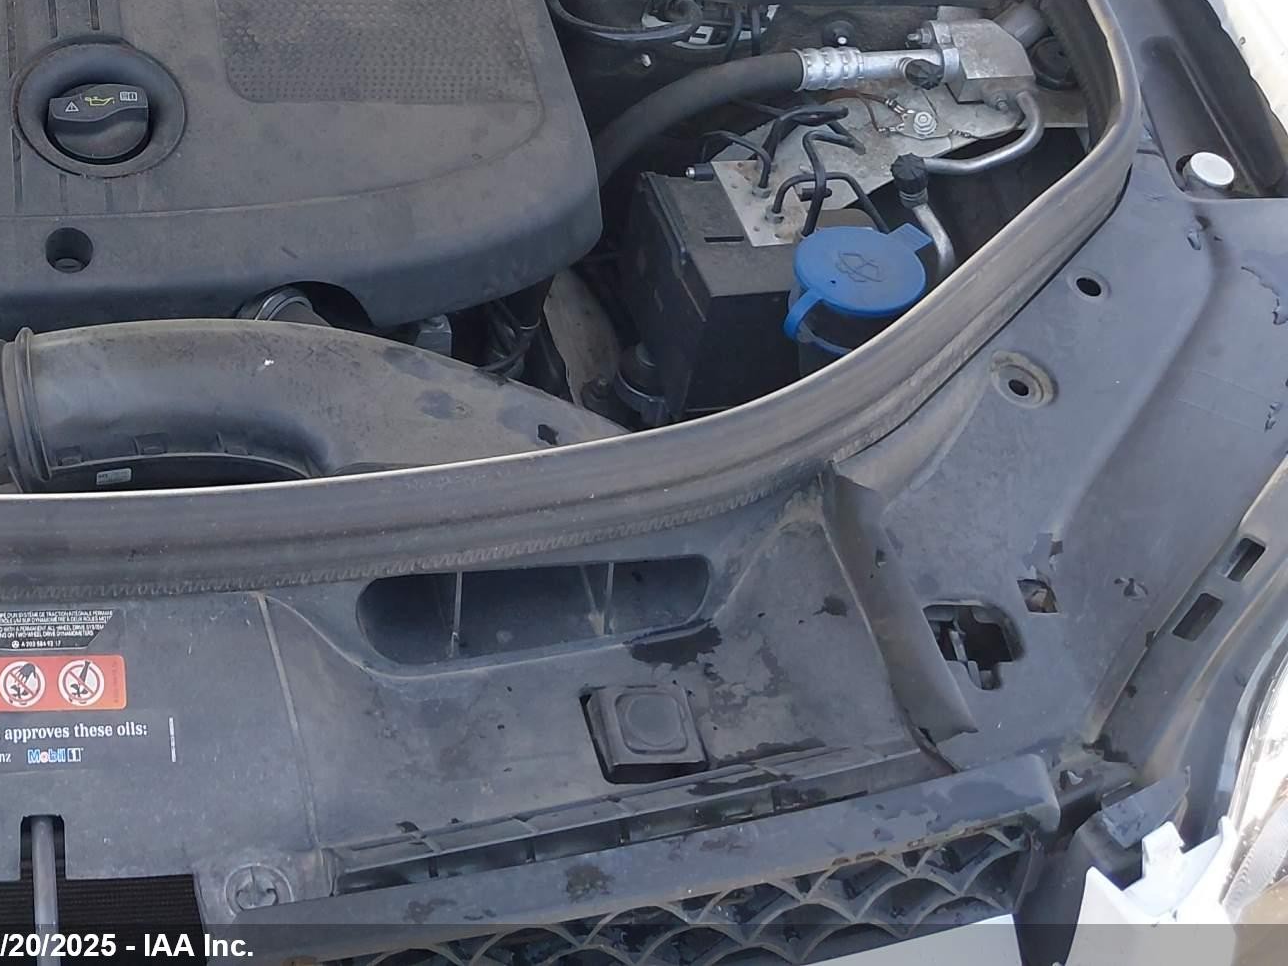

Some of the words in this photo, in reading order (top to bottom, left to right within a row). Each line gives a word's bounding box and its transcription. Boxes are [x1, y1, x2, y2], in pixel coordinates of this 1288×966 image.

[4, 726, 70, 744] approves
[74, 723, 113, 738] these
[117, 722, 148, 736] oils:
[27, 749, 65, 764] Mobil
